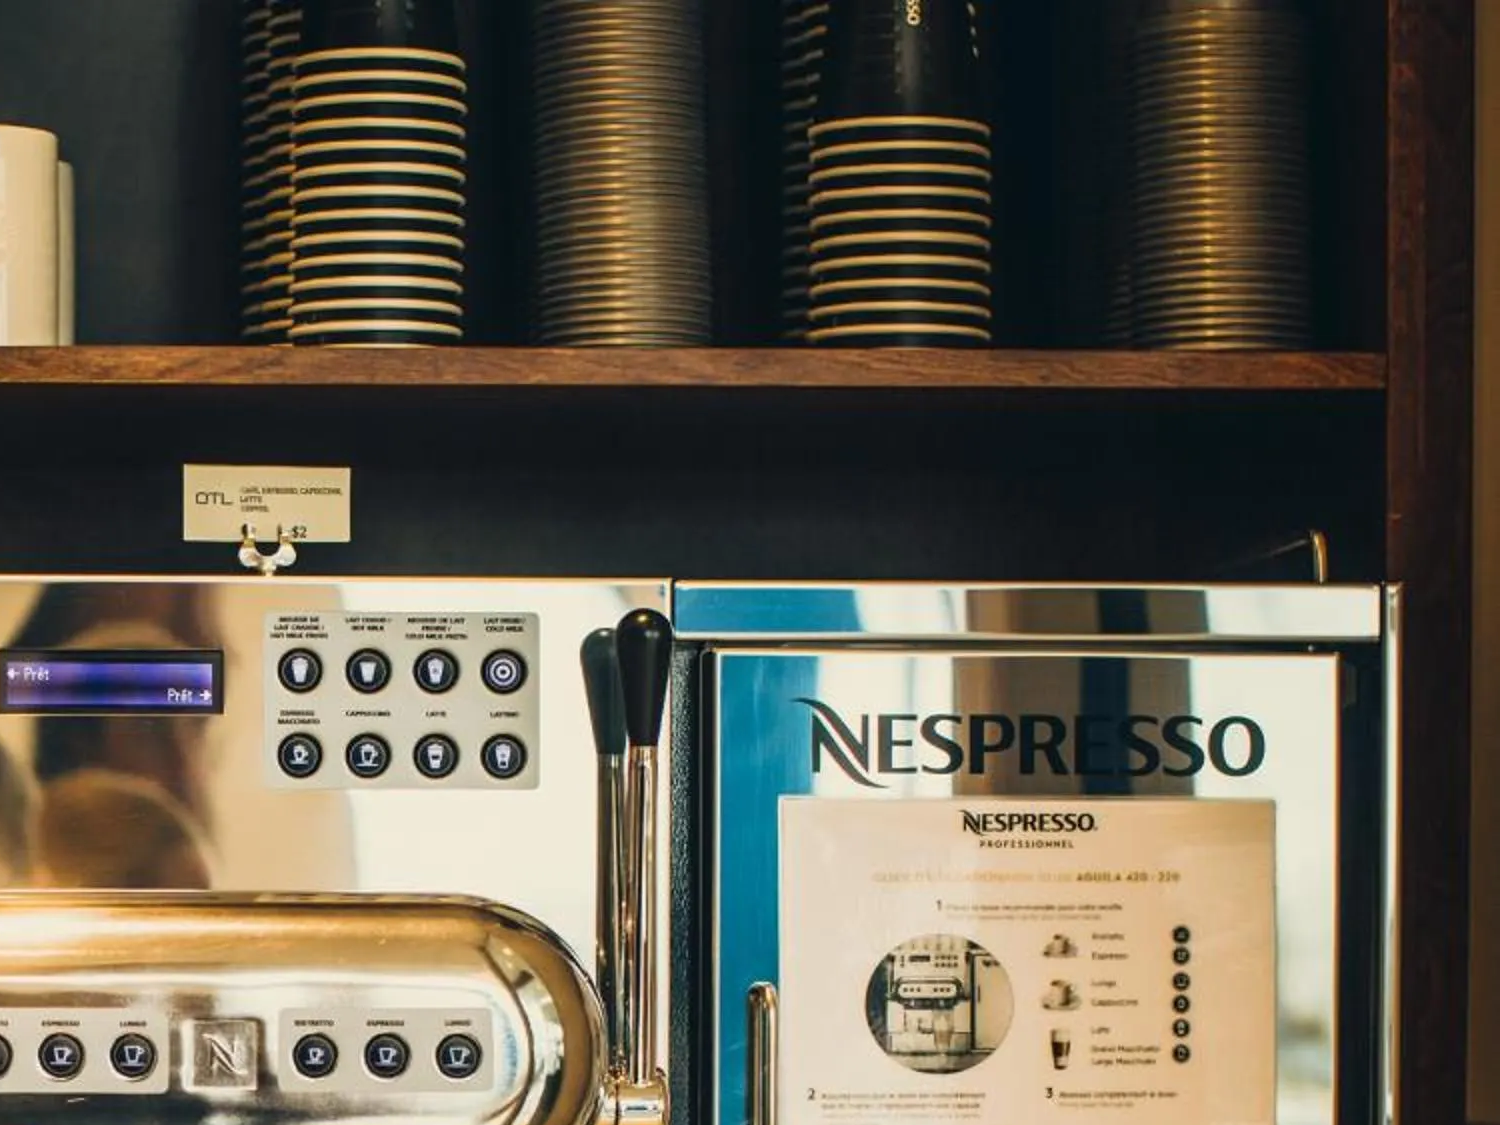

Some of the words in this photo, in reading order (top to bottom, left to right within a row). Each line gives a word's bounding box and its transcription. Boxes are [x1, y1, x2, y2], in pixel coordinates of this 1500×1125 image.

[792, 698, 1266, 788] NESPRESSO
[958, 810, 1096, 835] NESPRESSO
[807, 1088, 816, 1100] 2
